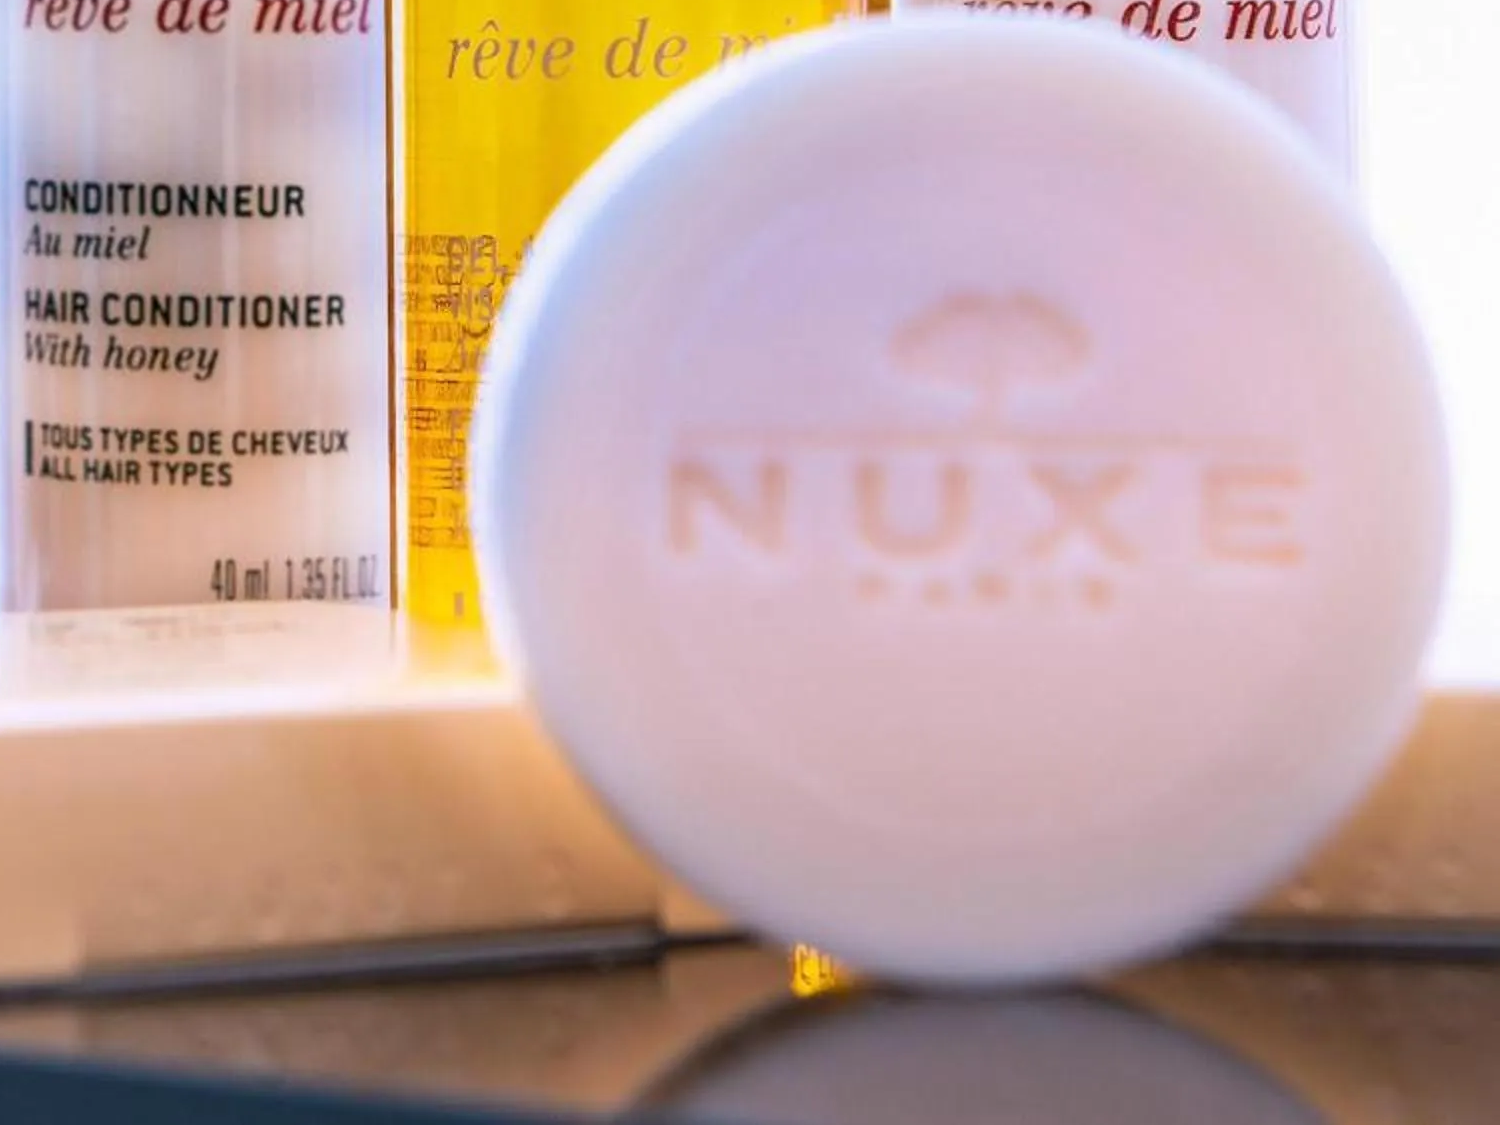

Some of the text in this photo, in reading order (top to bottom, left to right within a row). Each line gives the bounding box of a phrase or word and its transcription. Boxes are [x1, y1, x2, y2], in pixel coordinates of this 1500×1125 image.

[447, 20, 575, 80] rêve
[604, 17, 688, 79] de
[25, 179, 305, 217] CONDITIONNEUR
[23, 224, 152, 260] Au miel
[25, 290, 345, 328] HAIR CONDITIONER
[25, 333, 219, 380] With honey
[40, 424, 349, 456] TOUS TYPES DE CHEVEUX
[40, 461, 232, 488] ALL HAIR TYPES
[664, 457, 1305, 565] NUXE
[211, 559, 237, 601] 40
[245, 559, 269, 600] ml
[285, 557, 326, 600] 1.35
